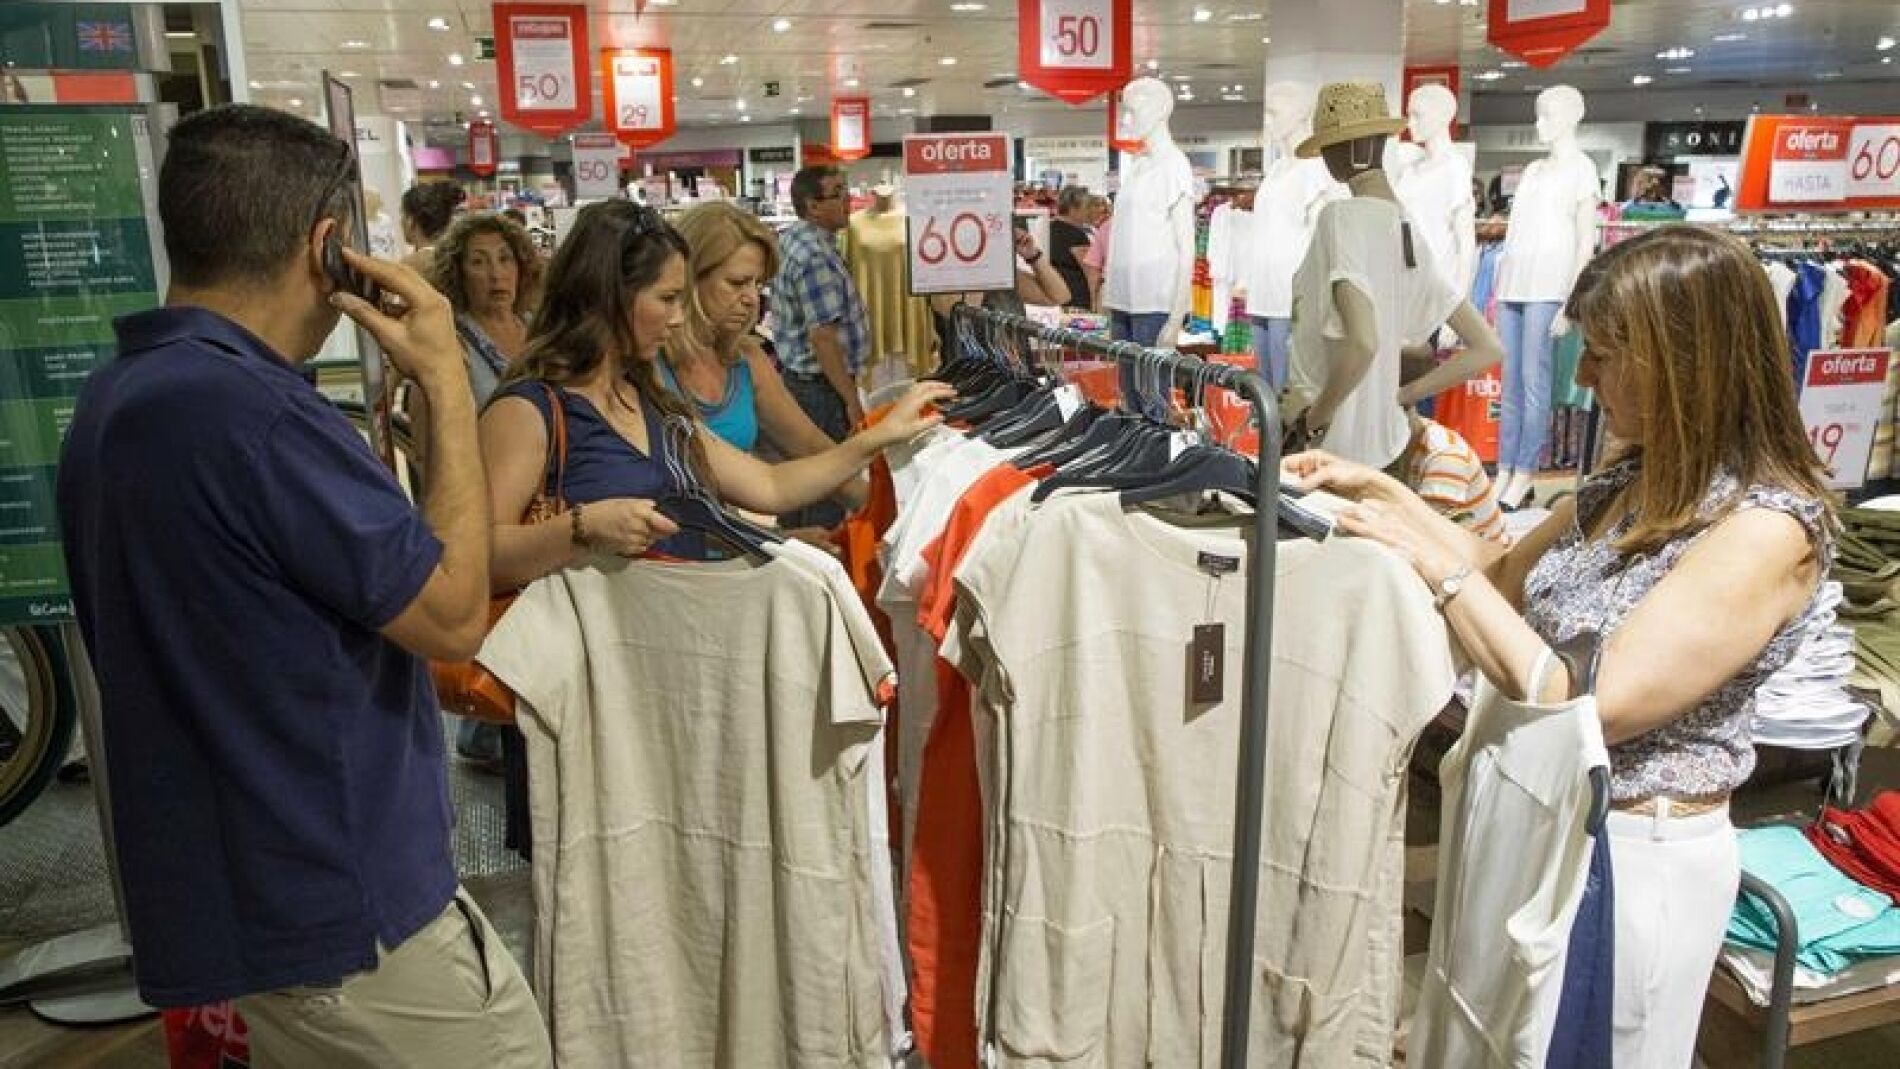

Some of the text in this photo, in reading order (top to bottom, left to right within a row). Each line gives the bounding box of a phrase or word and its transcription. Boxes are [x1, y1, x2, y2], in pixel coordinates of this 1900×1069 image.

[920, 140, 992, 160] oferta
[1786, 129, 1839, 151] oferta
[1822, 355, 1876, 374] oferta
